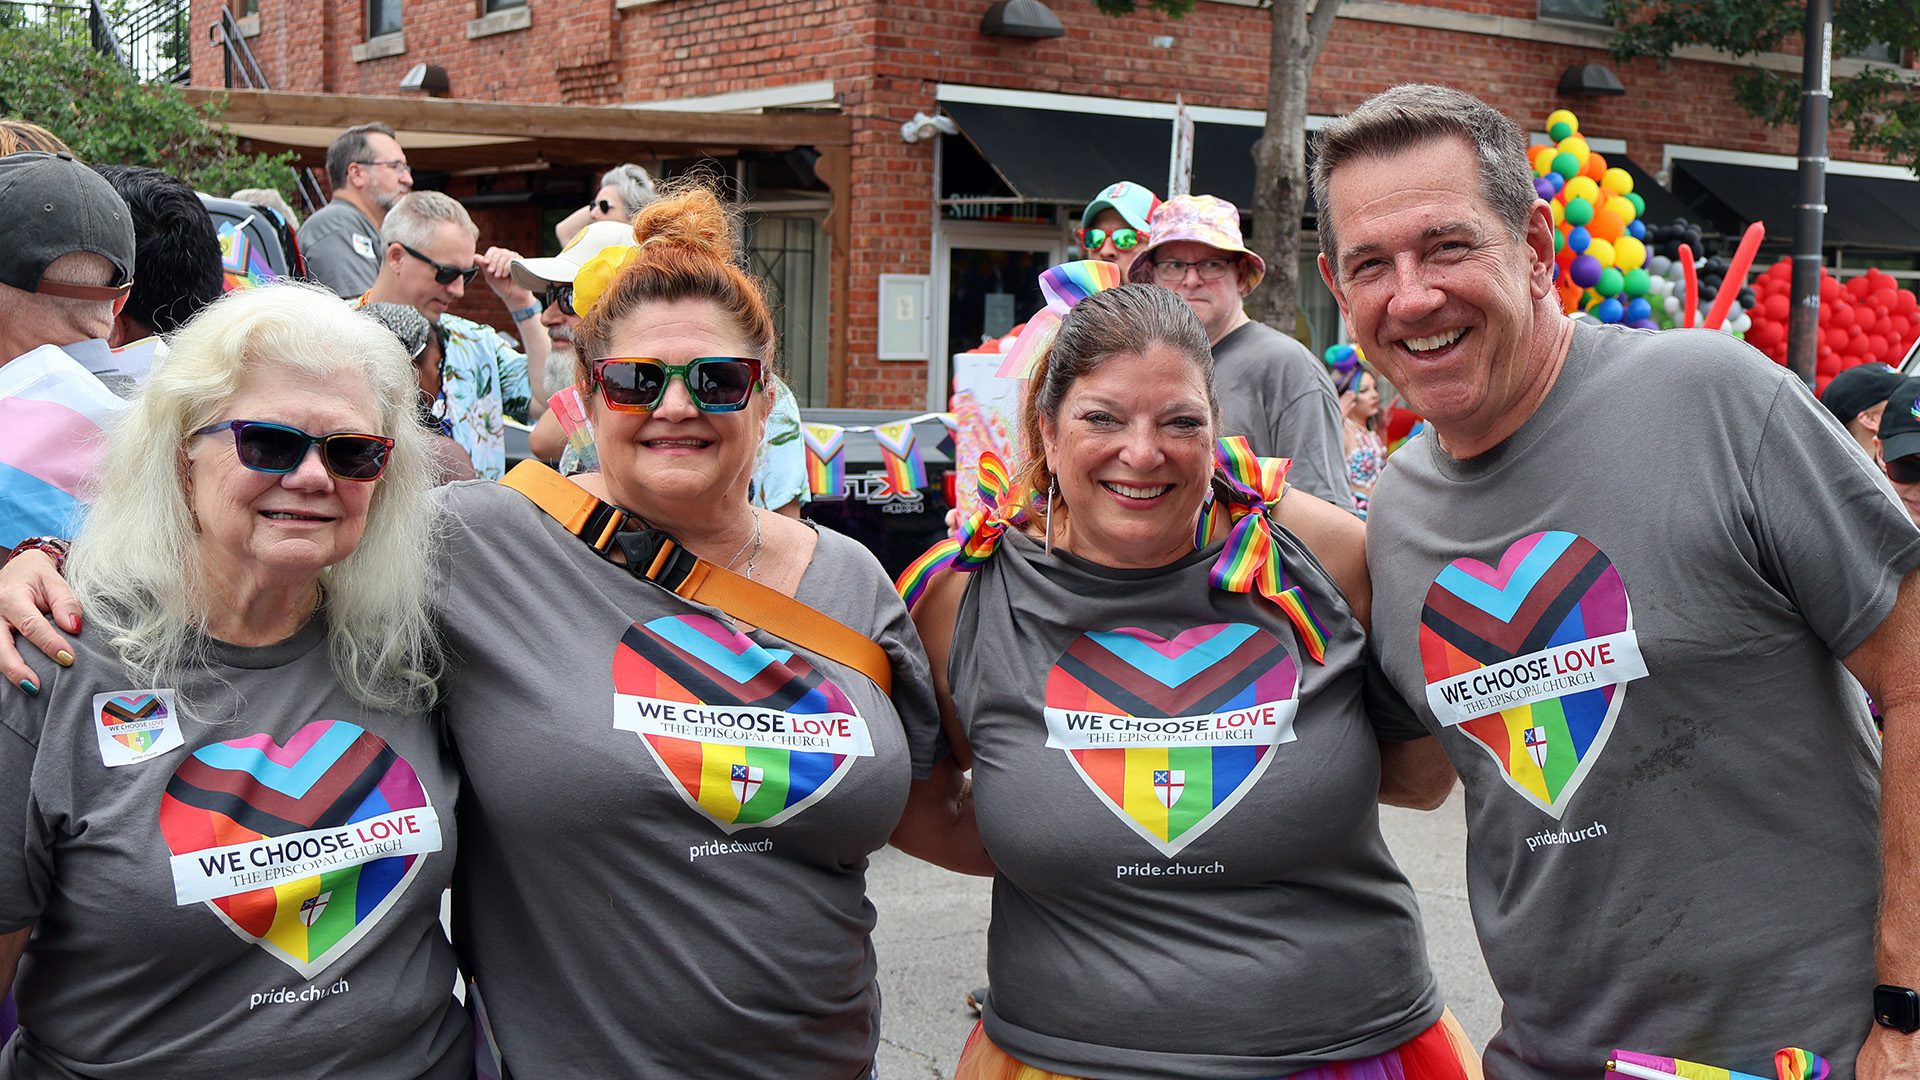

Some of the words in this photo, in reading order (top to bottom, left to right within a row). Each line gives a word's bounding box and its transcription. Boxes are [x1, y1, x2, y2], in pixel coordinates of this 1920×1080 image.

[813, 470, 924, 504] TX
[1440, 681, 1472, 705] WE
[1473, 657, 1551, 696] CHOOSE
[1553, 643, 1615, 675] LOVE
[1464, 699, 1487, 715] THE
[1489, 684, 1542, 709] EPISCOPAL
[1542, 671, 1596, 693] CHURCH
[120, 720, 149, 731] CHOOSE
[148, 719, 165, 727] LOVE
[637, 701, 676, 722] WE
[683, 709, 786, 733] CHOOSE
[792, 718, 852, 737] LOVE
[1066, 713, 1103, 731] WE
[1109, 718, 1209, 734] CHOOSE
[1216, 707, 1276, 730] LOVE
[661, 722, 691, 735] THE
[694, 726, 770, 743] EPISCOPAL
[772, 734, 831, 748] CHURCH
[1087, 732, 1115, 743] THE
[1118, 732, 1192, 743] EPISCOPAL
[1195, 729, 1254, 742] CHURCH
[199, 850, 245, 877] WE
[249, 832, 354, 867] CHOOSE
[356, 815, 421, 843] LOVE
[689, 838, 774, 862] pride.church
[230, 872, 262, 887] THE
[264, 856, 342, 880] EPISCOPAL
[344, 839, 402, 861] CHURCH
[1116, 861, 1225, 879] pride.church
